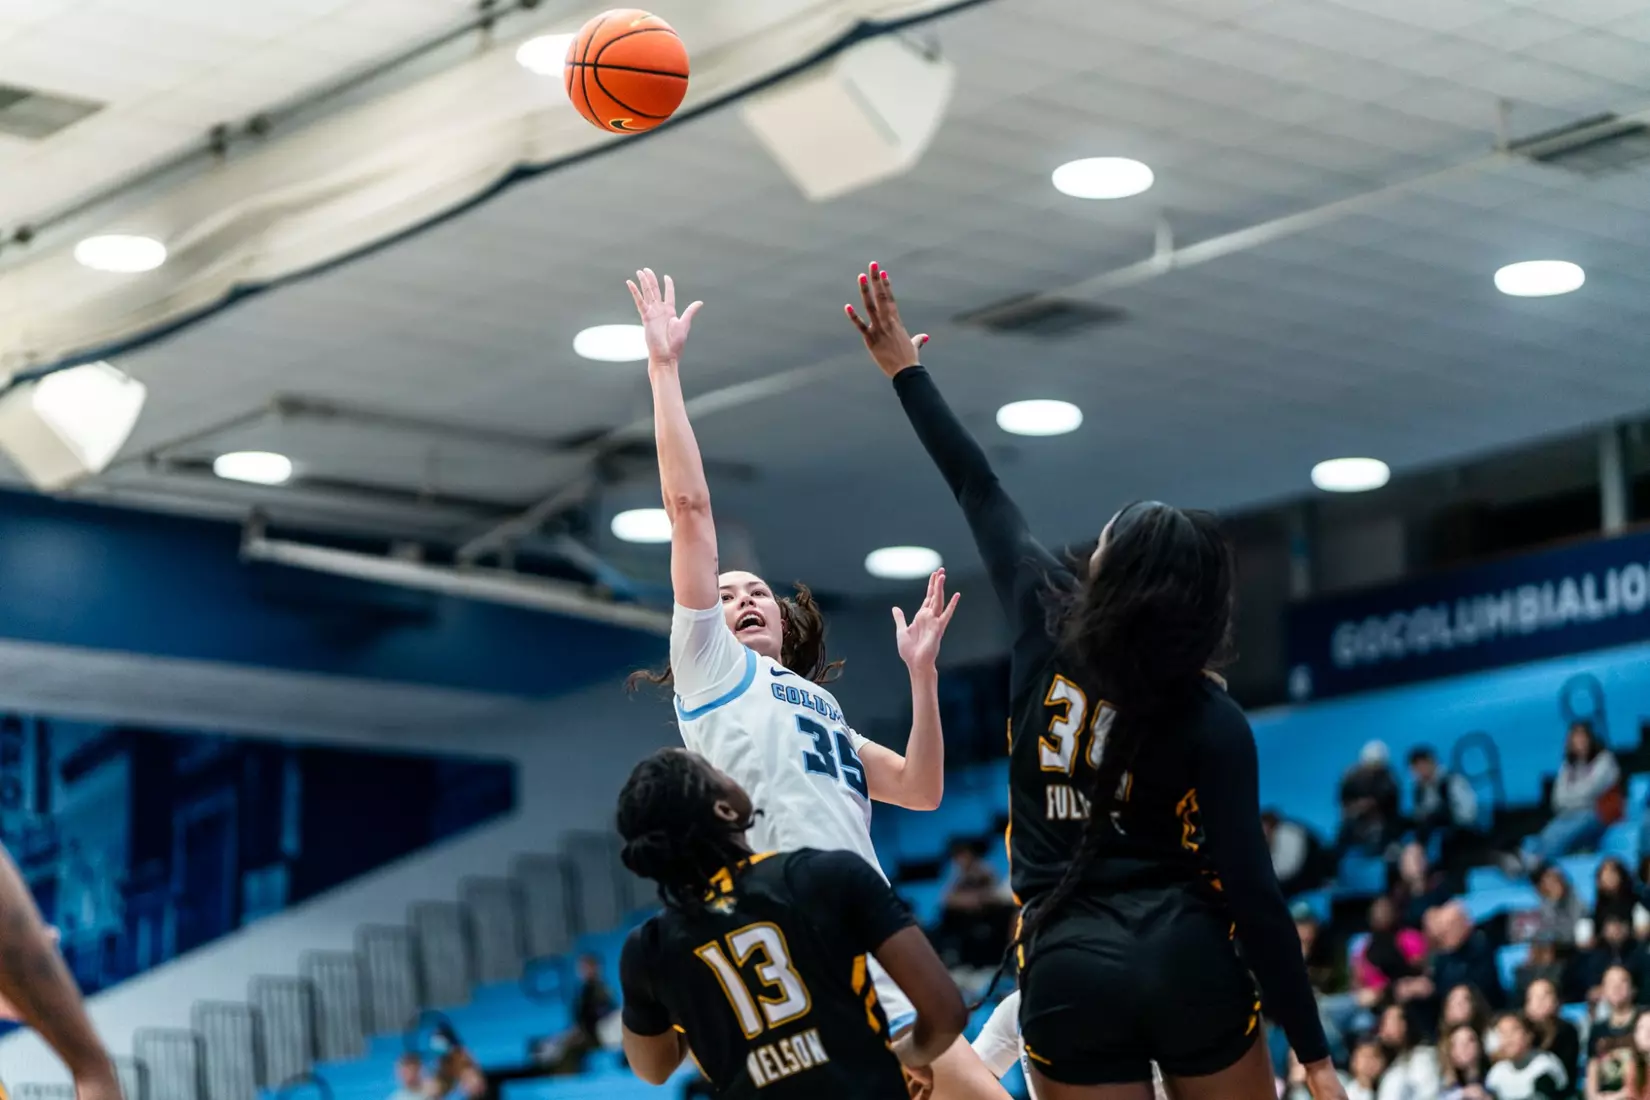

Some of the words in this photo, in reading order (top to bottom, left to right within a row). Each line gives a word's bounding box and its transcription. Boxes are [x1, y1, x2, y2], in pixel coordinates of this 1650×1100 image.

[1332, 562, 1650, 668] GOCOLUMBIALIO
[795, 714, 869, 801] 35
[693, 921, 812, 1040] 13
[747, 1028, 830, 1088] NELSON
